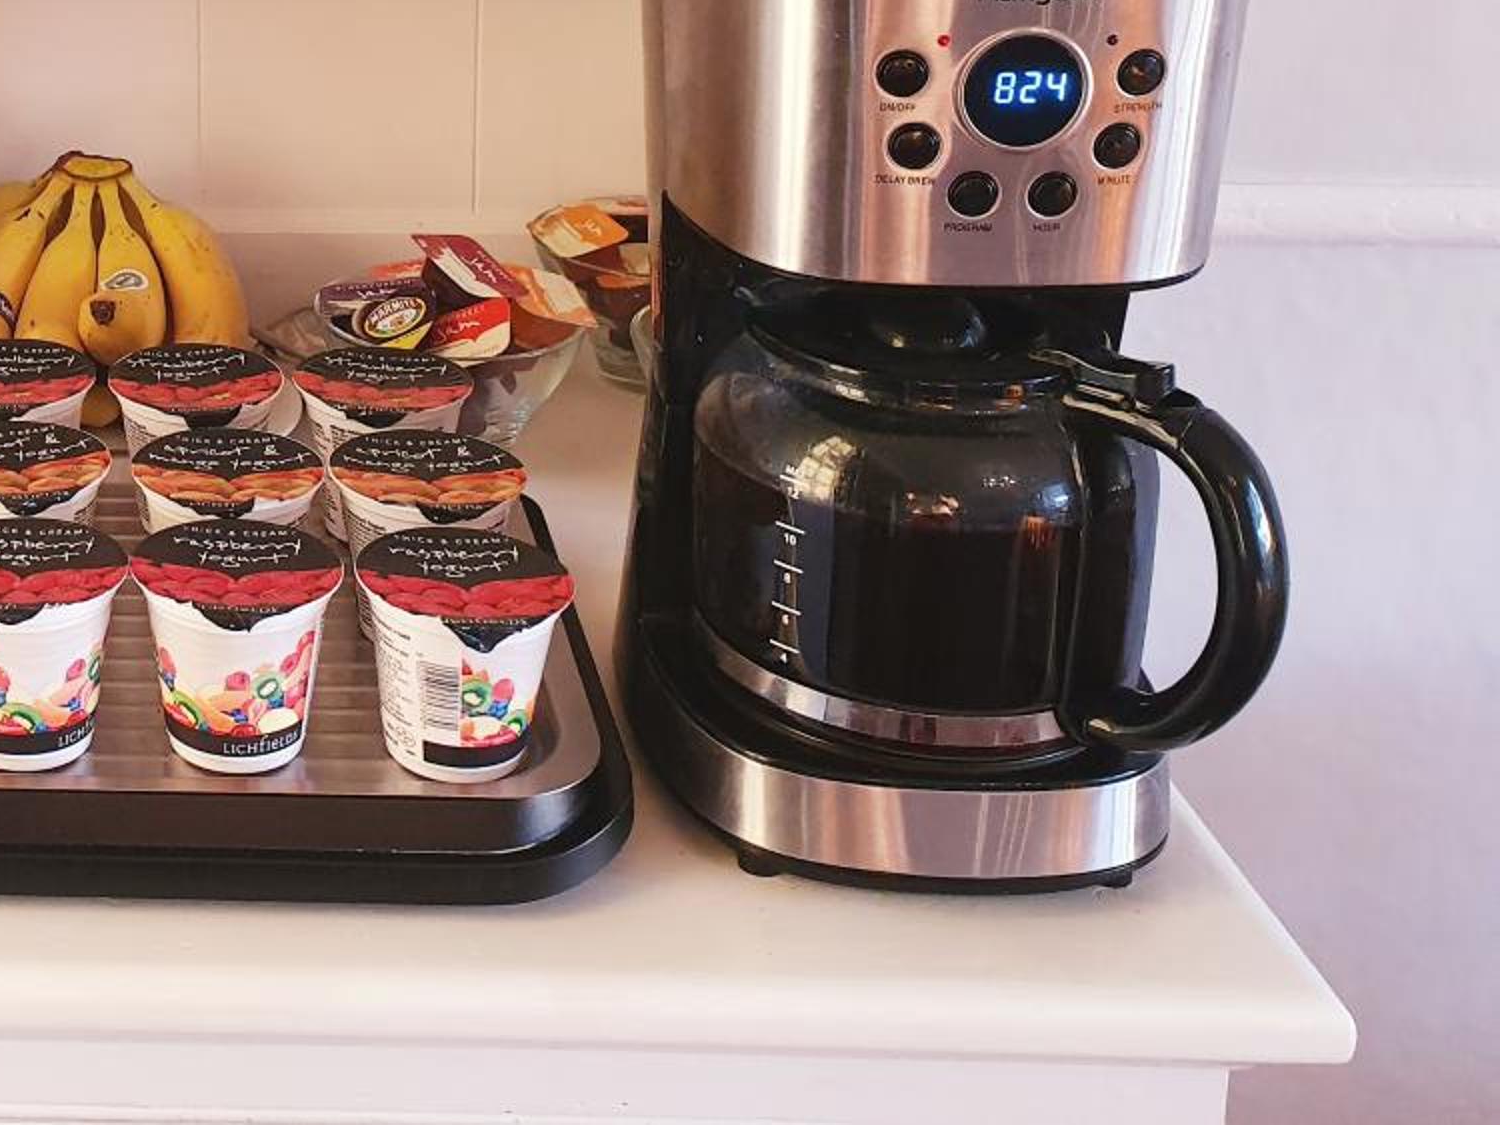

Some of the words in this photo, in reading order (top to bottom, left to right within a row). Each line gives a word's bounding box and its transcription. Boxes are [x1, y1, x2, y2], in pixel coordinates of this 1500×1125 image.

[874, 175, 906, 186] DELAY
[173, 536, 301, 555] raspberry
[783, 532, 797, 547] 10
[198, 550, 289, 568] yogurt
[388, 545, 519, 563] raspberry
[416, 559, 510, 578] yogurt
[783, 571, 791, 584] 8
[781, 613, 789, 626] 6
[779, 651, 788, 664] 4
